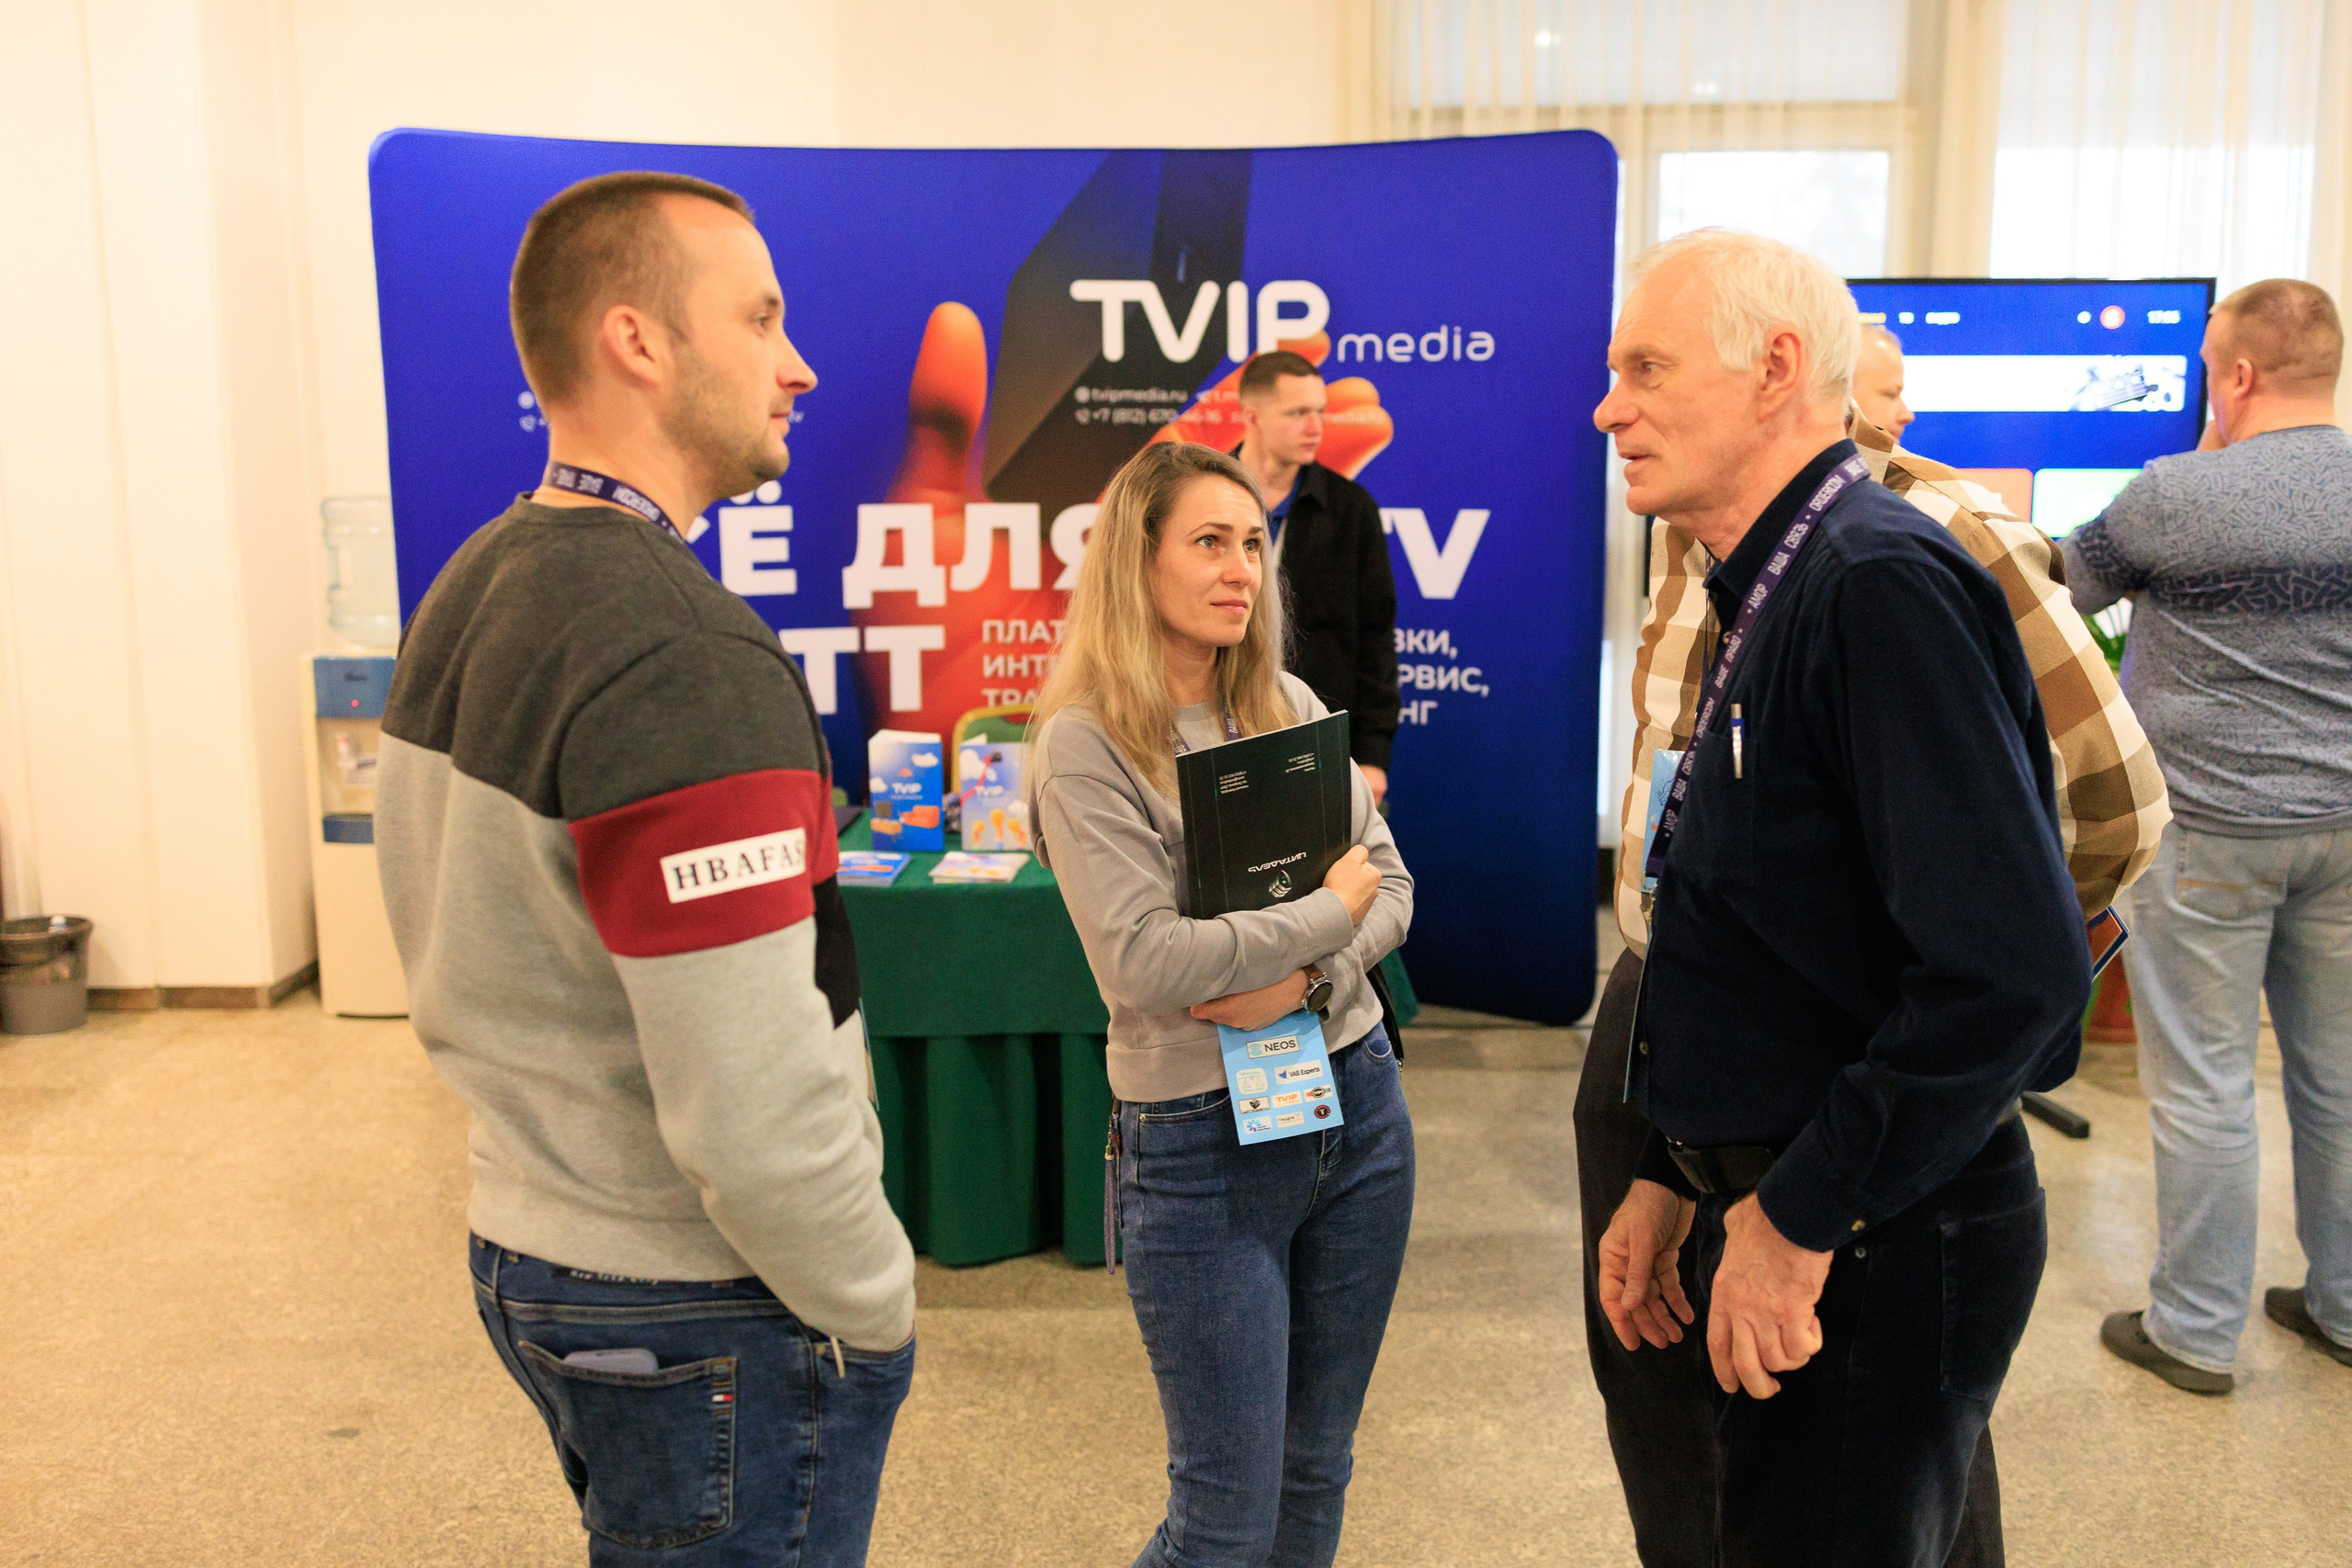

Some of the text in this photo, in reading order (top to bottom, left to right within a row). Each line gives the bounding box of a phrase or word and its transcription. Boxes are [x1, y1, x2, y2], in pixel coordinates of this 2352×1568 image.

[1069, 280, 1496, 364] TVIP media
[1378, 507, 1492, 600] V
[1767, 551, 1791, 576] ВАША
[1264, 1039, 1296, 1053] NEOS
[1288, 1066, 1320, 1077] VAS Experts
[1275, 1094, 1298, 1103] TVIP
